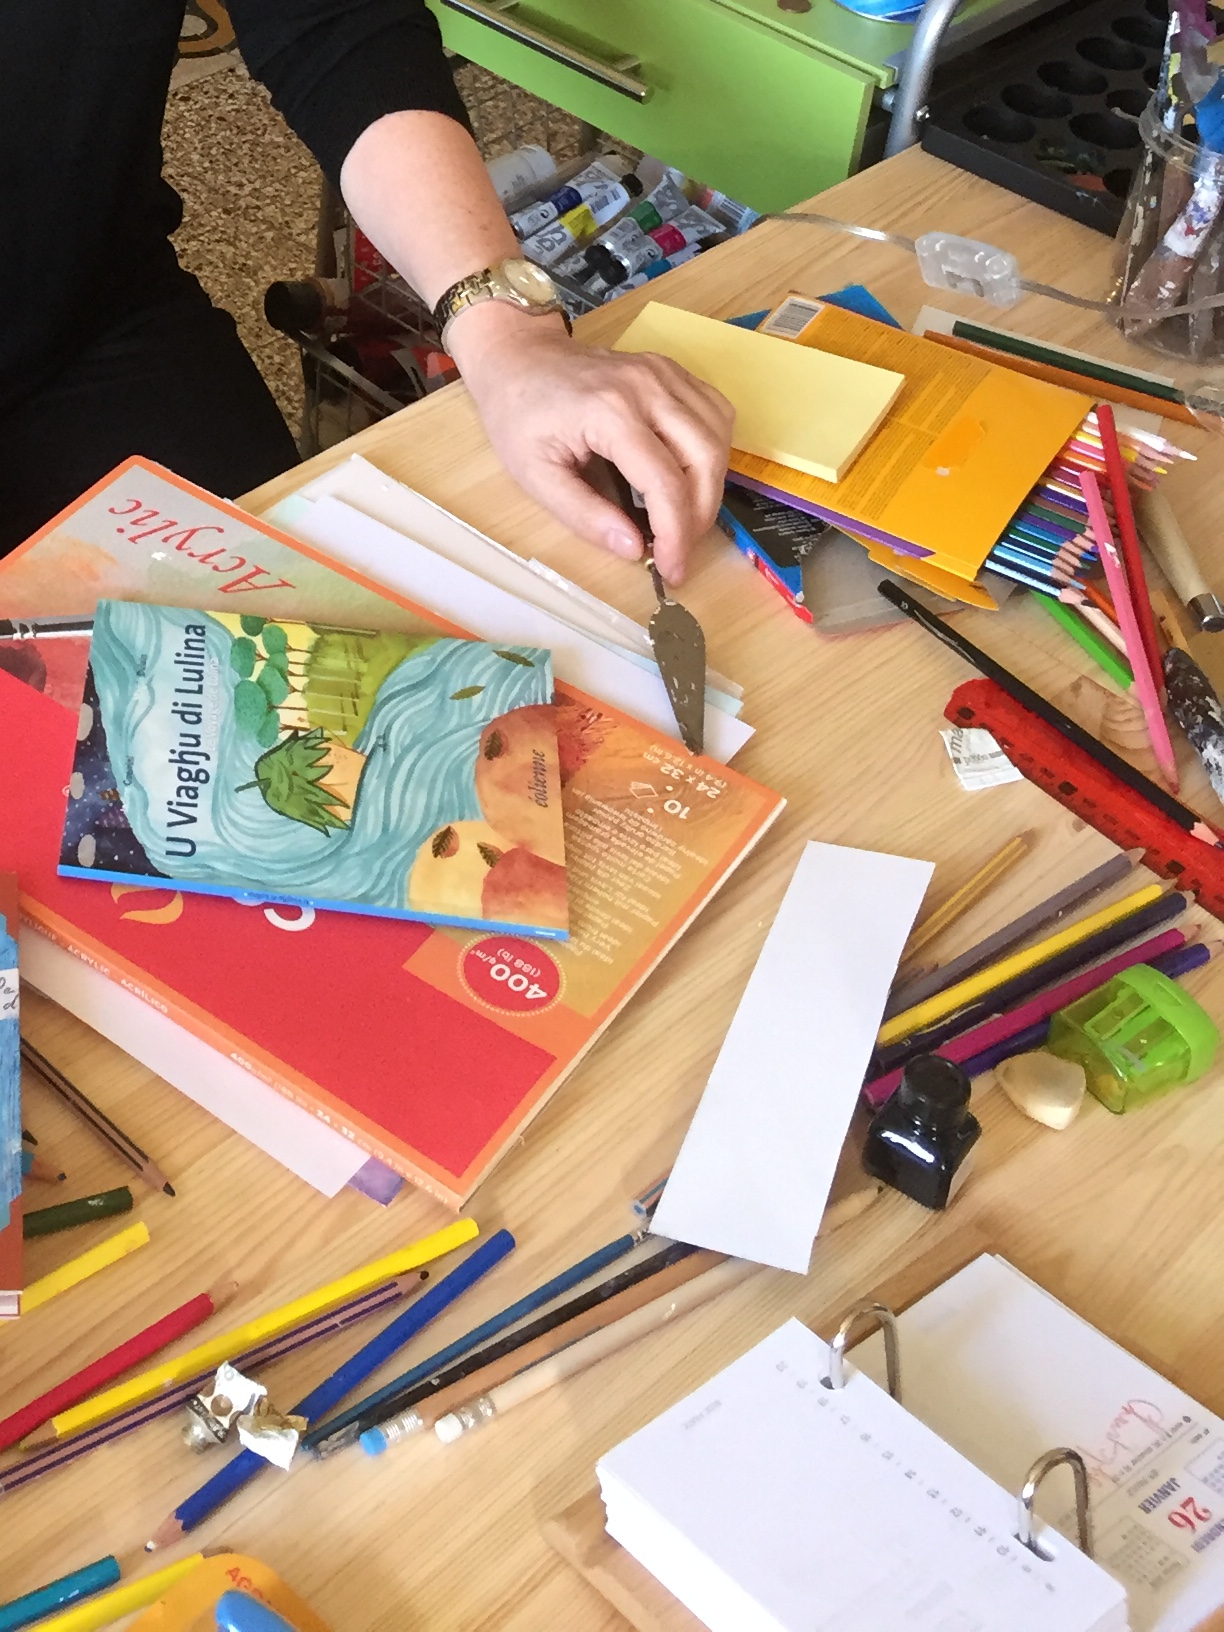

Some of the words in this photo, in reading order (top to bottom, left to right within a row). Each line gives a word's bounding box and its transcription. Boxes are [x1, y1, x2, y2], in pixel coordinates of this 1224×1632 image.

[108, 498, 296, 593] Acrylic
[173, 623, 207, 696] Lulina
[171, 701, 203, 726] di
[643, 751, 659, 764] cm
[660, 761, 683, 781] 32
[685, 773, 696, 784] x
[696, 779, 719, 799] 24
[662, 796, 691, 820] 10
[165, 836, 197, 858] U
[495, 947, 514, 963] lb)
[512, 957, 541, 978] (188
[1137, 1476, 1182, 1515] JANVIER
[1168, 1496, 1213, 1535] 26
